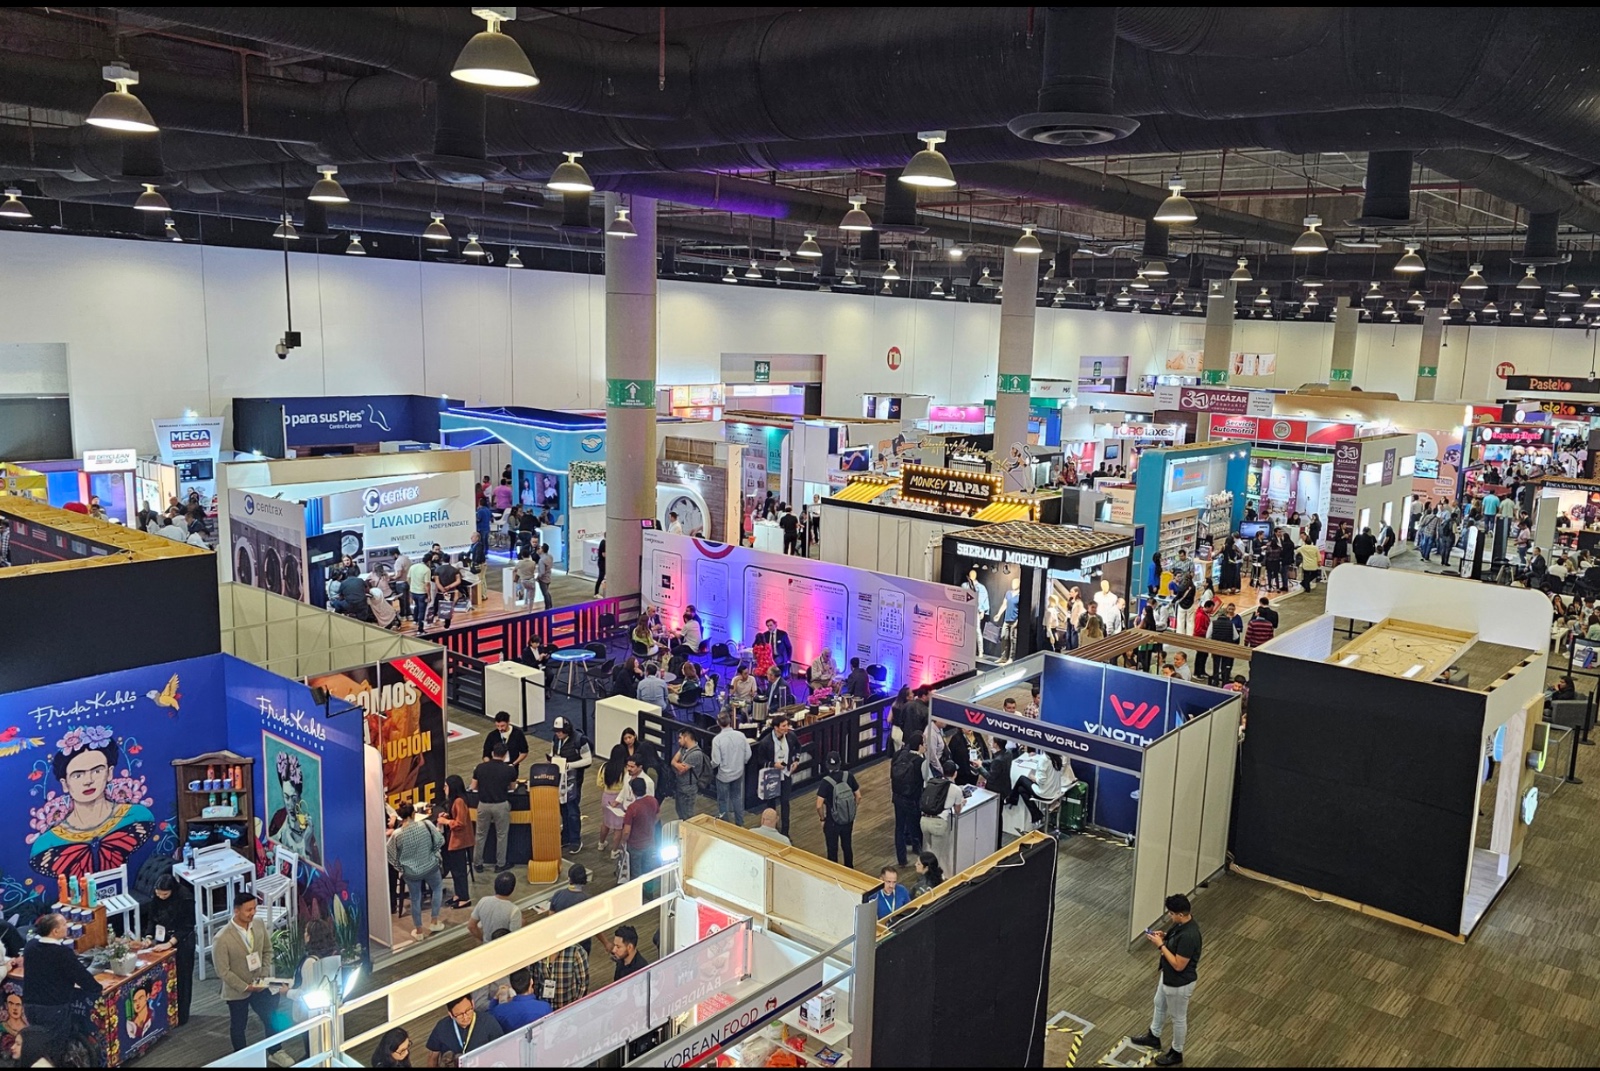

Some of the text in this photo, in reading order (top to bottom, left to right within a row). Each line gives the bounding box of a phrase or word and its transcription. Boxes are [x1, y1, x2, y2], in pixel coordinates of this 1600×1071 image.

[1529, 378, 1572, 391] Pasteko
[1210, 393, 1247, 403] ALCÁZAR
[1539, 401, 1576, 415] steko
[292, 413, 318, 427] para
[320, 412, 338, 423] sus
[1225, 420, 1255, 428] Servicio
[171, 430, 209, 441] MEGA
[1212, 425, 1255, 435] Automotriz
[909, 475, 989, 496] MONKEY PAPAS
[381, 486, 419, 505] centrax
[256, 503, 283, 516] centrax
[372, 509, 449, 529] LAVANDERÍA
[429, 520, 469, 530] INDEPENDIZATE
[391, 534, 416, 542] INVIERTE
[956, 542, 1049, 569] SHERMAN MORGAN
[403, 659, 426, 687] SPECIAL
[424, 676, 441, 695] OFFER
[28, 691, 137, 723] Frida Kahlo
[256, 695, 294, 727] Frida
[291, 709, 326, 741] Kahlo
[381, 730, 431, 764] LUCIÓN
[1044, 732, 1089, 752] WORLD
[664, 1008, 758, 1068] KOREAN FOOD
